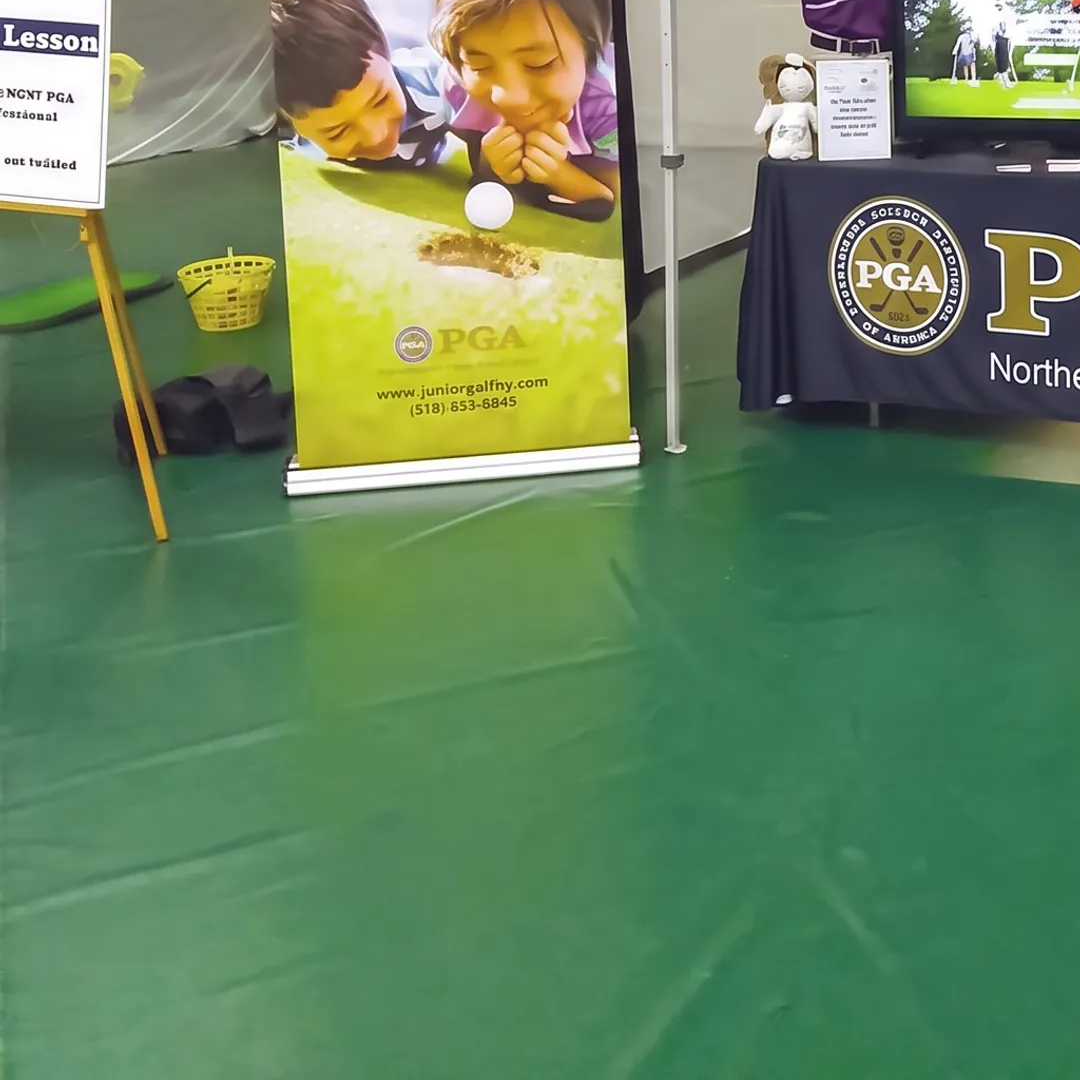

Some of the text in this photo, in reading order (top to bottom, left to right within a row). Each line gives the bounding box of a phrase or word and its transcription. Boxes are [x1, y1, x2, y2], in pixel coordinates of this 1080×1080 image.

[3, 24, 98, 53] Lesson
[46, 91, 75, 104] PGA
[855, 260, 942, 294] PGA
[437, 324, 527, 354] PGA
[862, 321, 880, 336] OF
[410, 401, 446, 418] (518)
